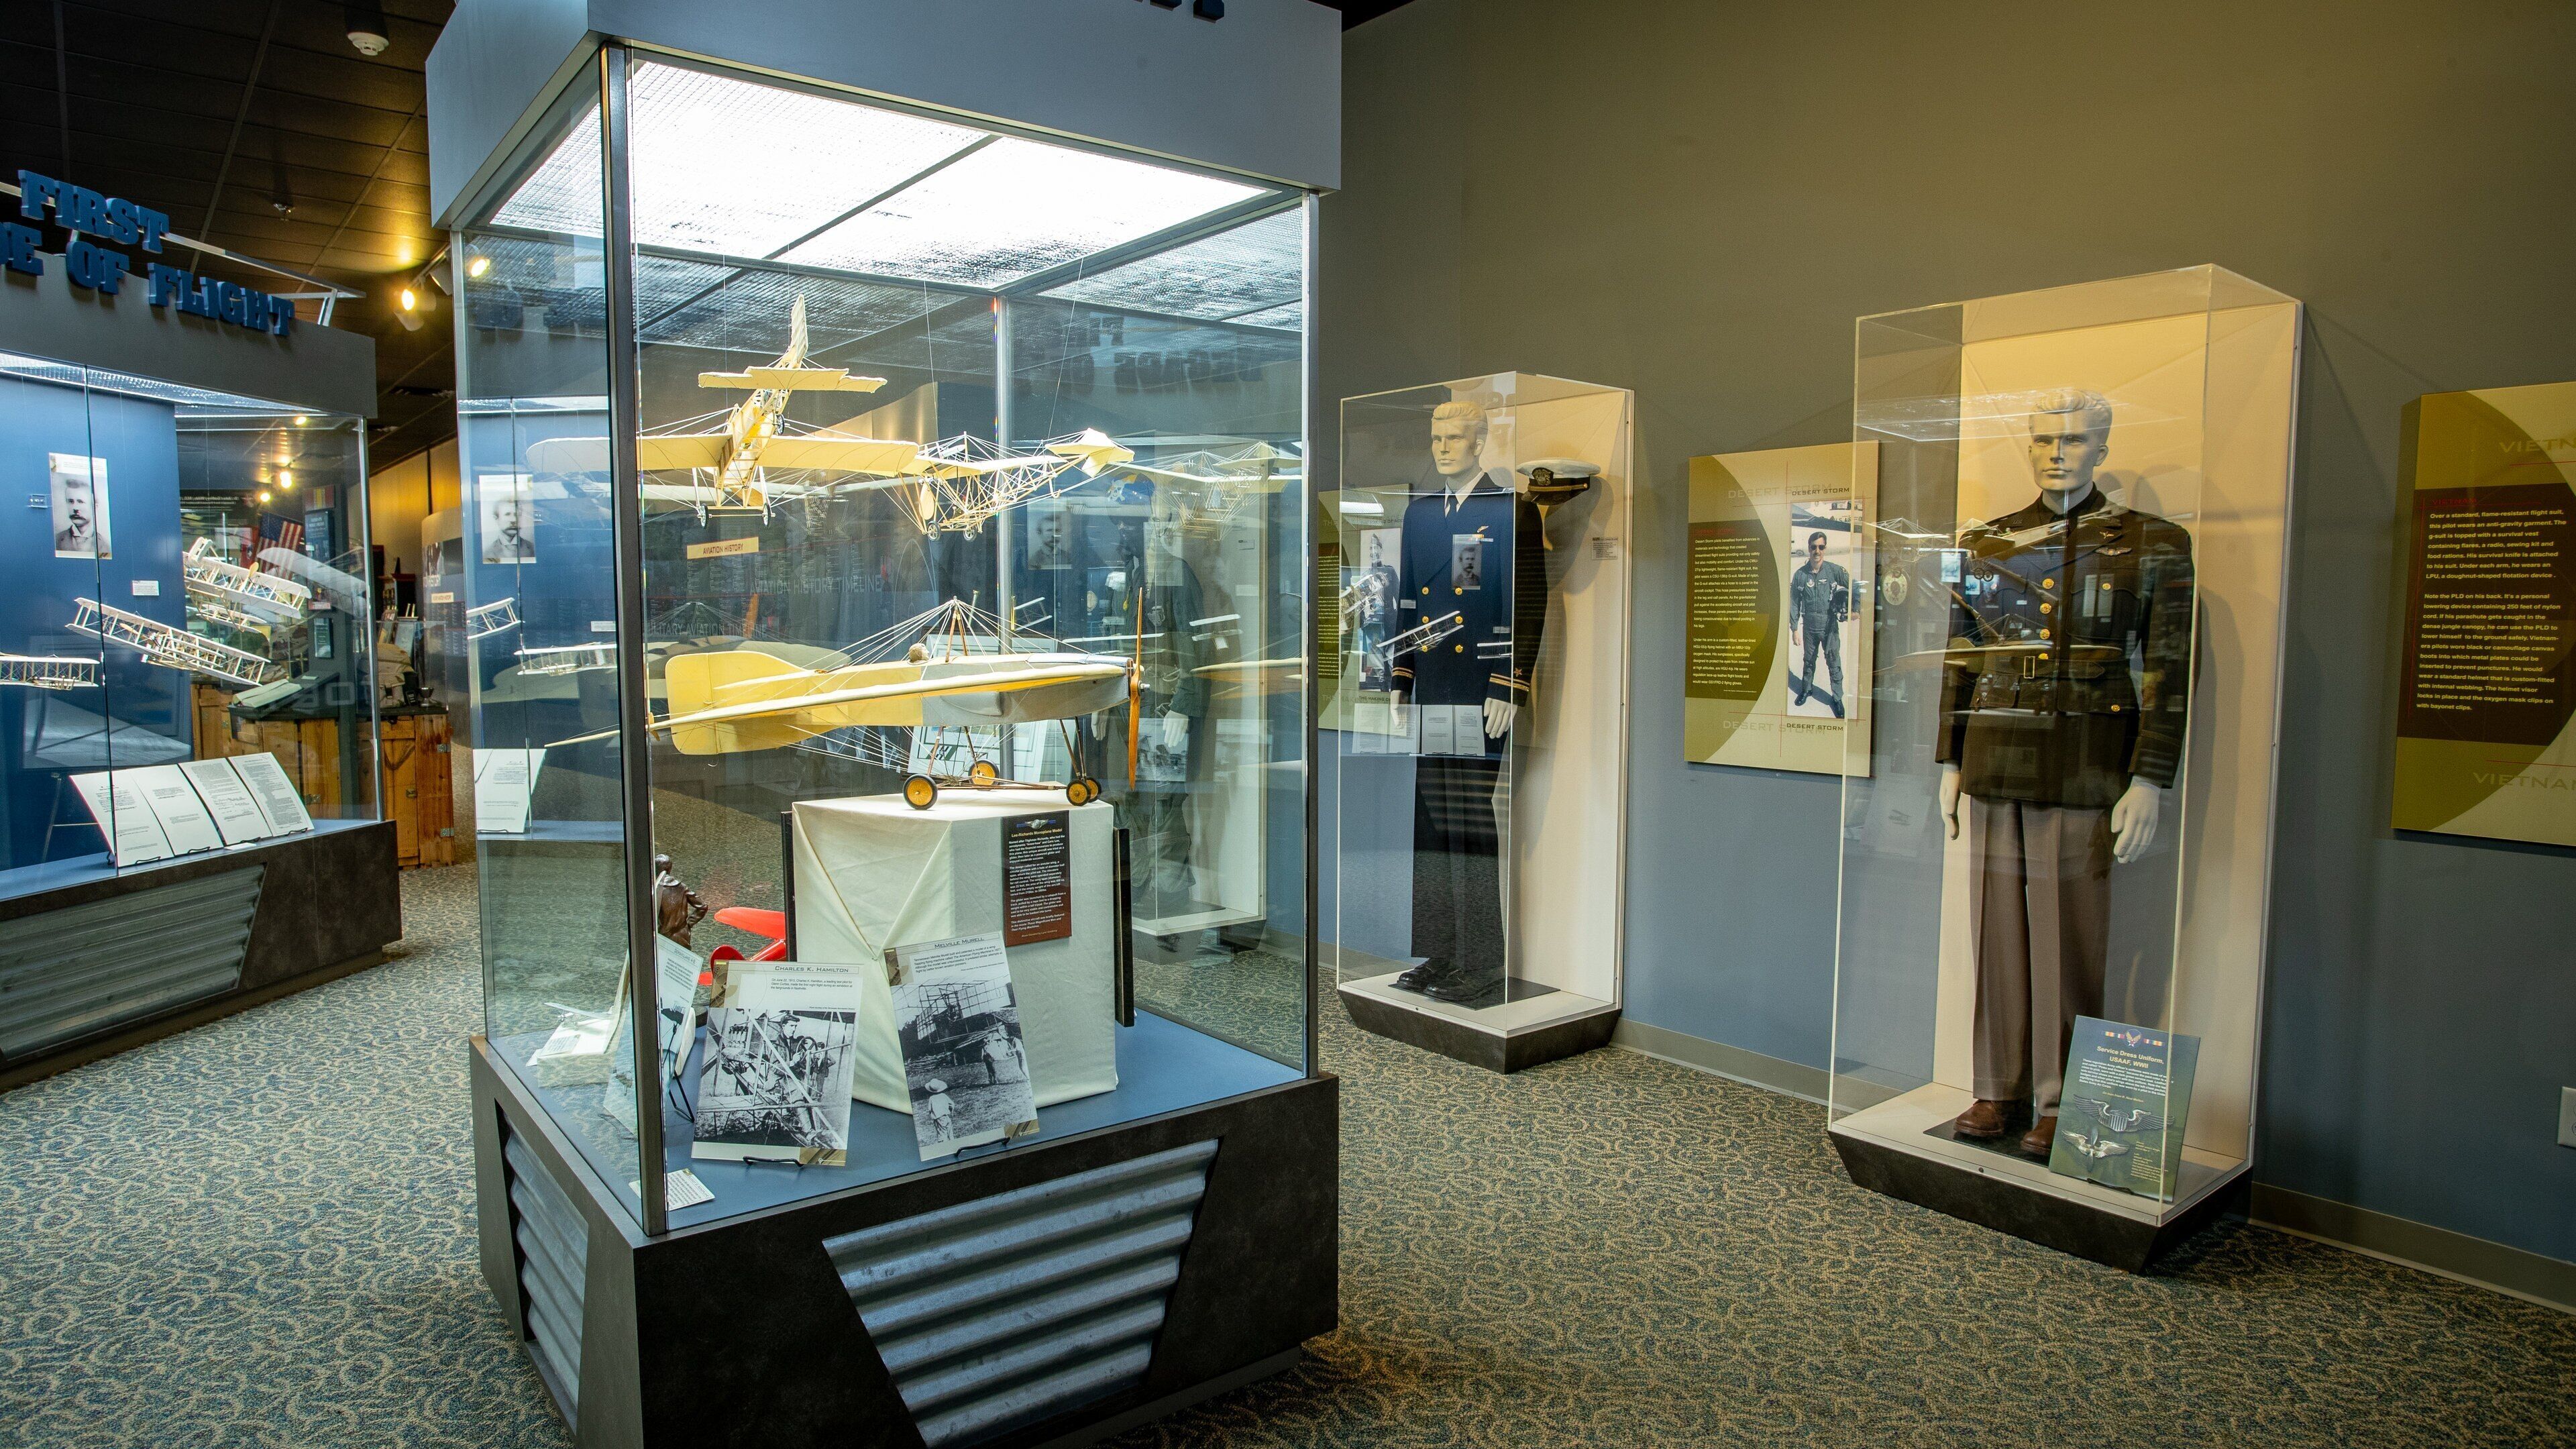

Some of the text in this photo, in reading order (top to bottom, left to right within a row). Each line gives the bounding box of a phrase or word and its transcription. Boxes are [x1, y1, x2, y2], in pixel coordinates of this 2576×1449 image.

[18, 170, 169, 254] FIRST
[0, 221, 295, 335] E OF FLIGHT
[1728, 487, 1779, 498] DESERT
[1792, 488, 1821, 496] DESERT
[702, 543, 744, 554] AVIATION HISTORY
[793, 576, 833, 594] HISTORY
[837, 574, 882, 593] TIMELINE
[728, 623, 767, 638] TIMINE
[1723, 720, 1774, 731] DESERT
[934, 940, 961, 949] MELVILLE
[2096, 1046, 2164, 1065] Service Dress Uniform,
[2109, 1056, 2149, 1069] USAAF, WWII
